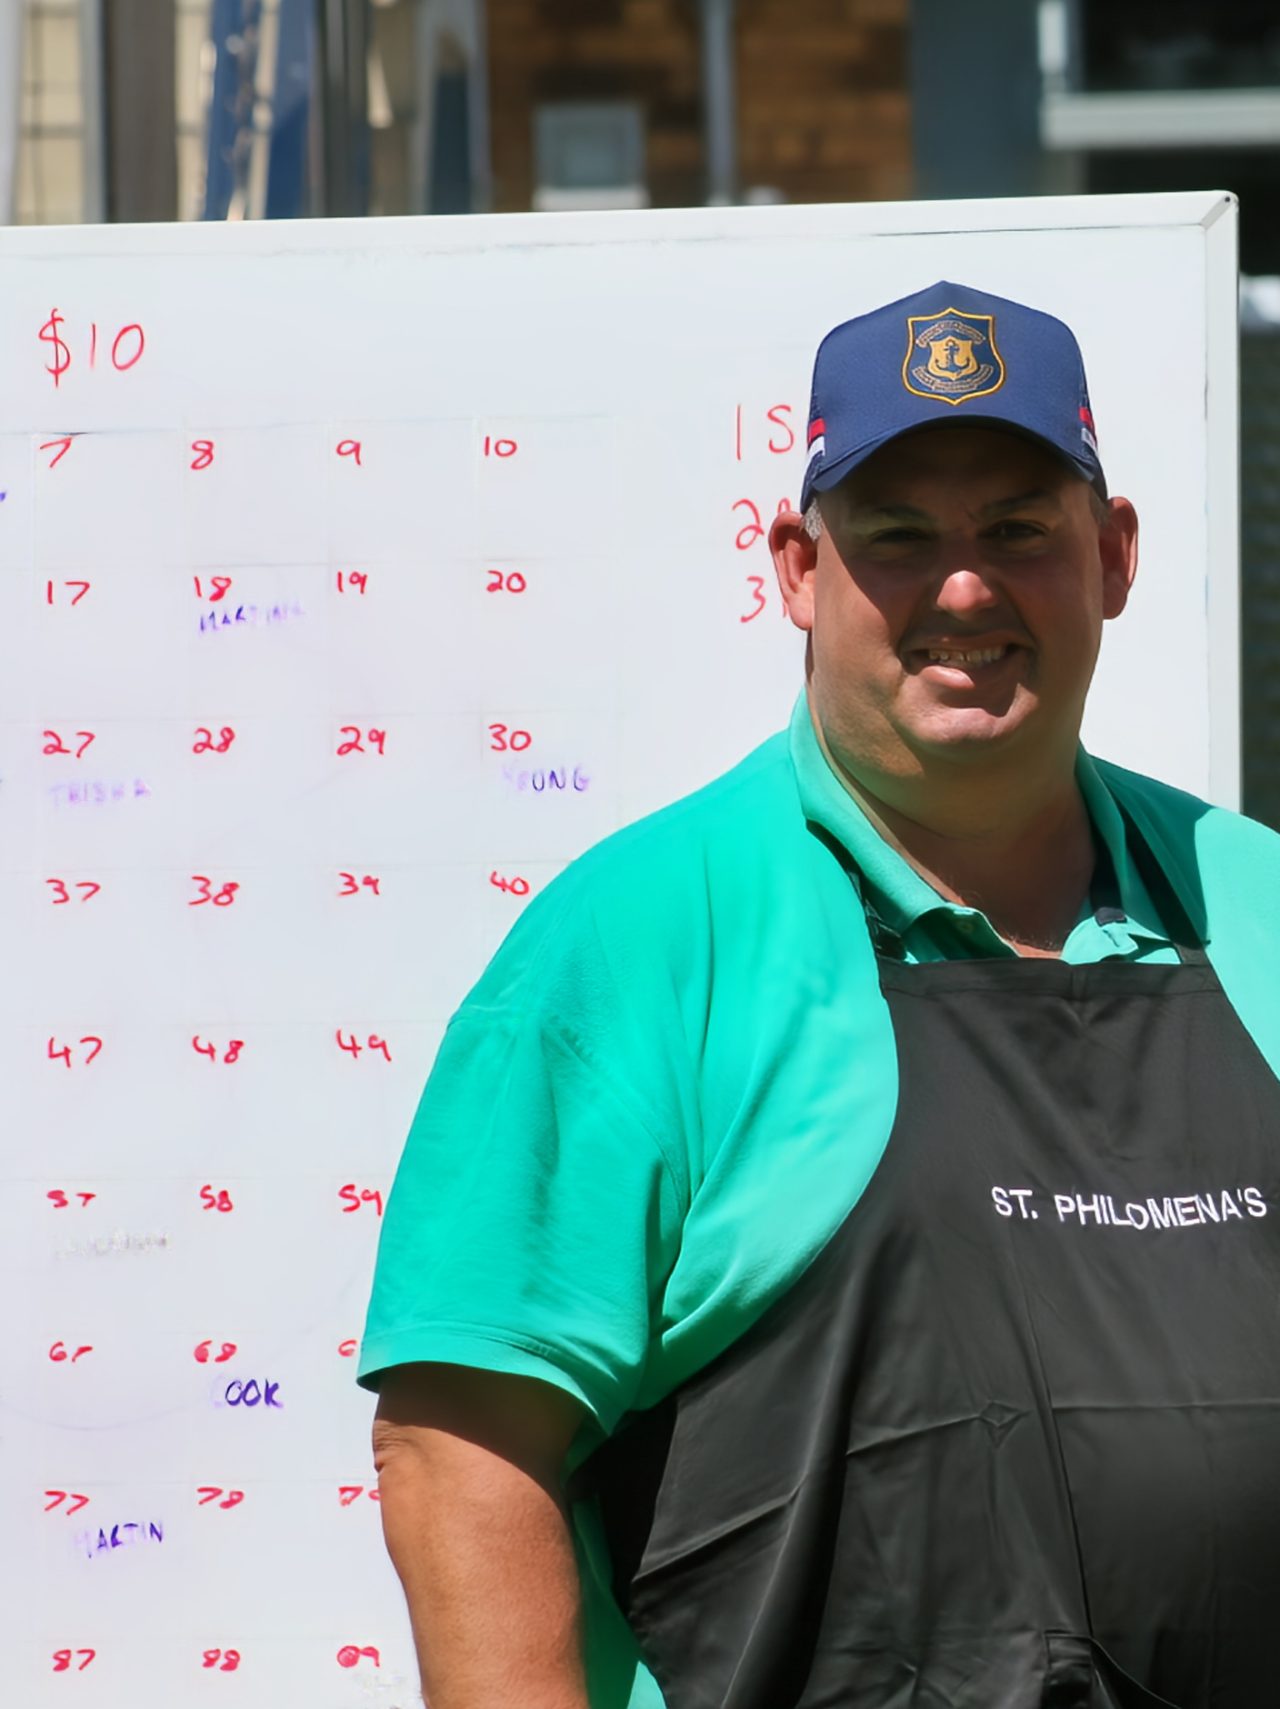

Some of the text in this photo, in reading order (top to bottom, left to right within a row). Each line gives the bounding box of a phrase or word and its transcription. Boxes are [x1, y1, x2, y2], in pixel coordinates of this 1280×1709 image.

[38, 308, 145, 387] $10
[735, 404, 795, 461] 15
[40, 436, 518, 471] 7 8 9 10
[732, 498, 792, 550] 2
[46, 570, 527, 606] 17 18 19 20
[42, 723, 533, 759] 27 28 29 30
[46, 871, 531, 907] 37 38 39 40
[47, 1029, 392, 1069] 47 48 49
[199, 1184, 234, 1213] 58
[338, 1184, 383, 1218] 59
[991, 1186, 1268, 1231] ST. PHILOMENA'S
[193, 1339, 238, 1364] 68
[44, 1490, 90, 1515] 77
[197, 1486, 244, 1510] 78
[52, 1648, 96, 1673] 87
[202, 1649, 241, 1673] 88
